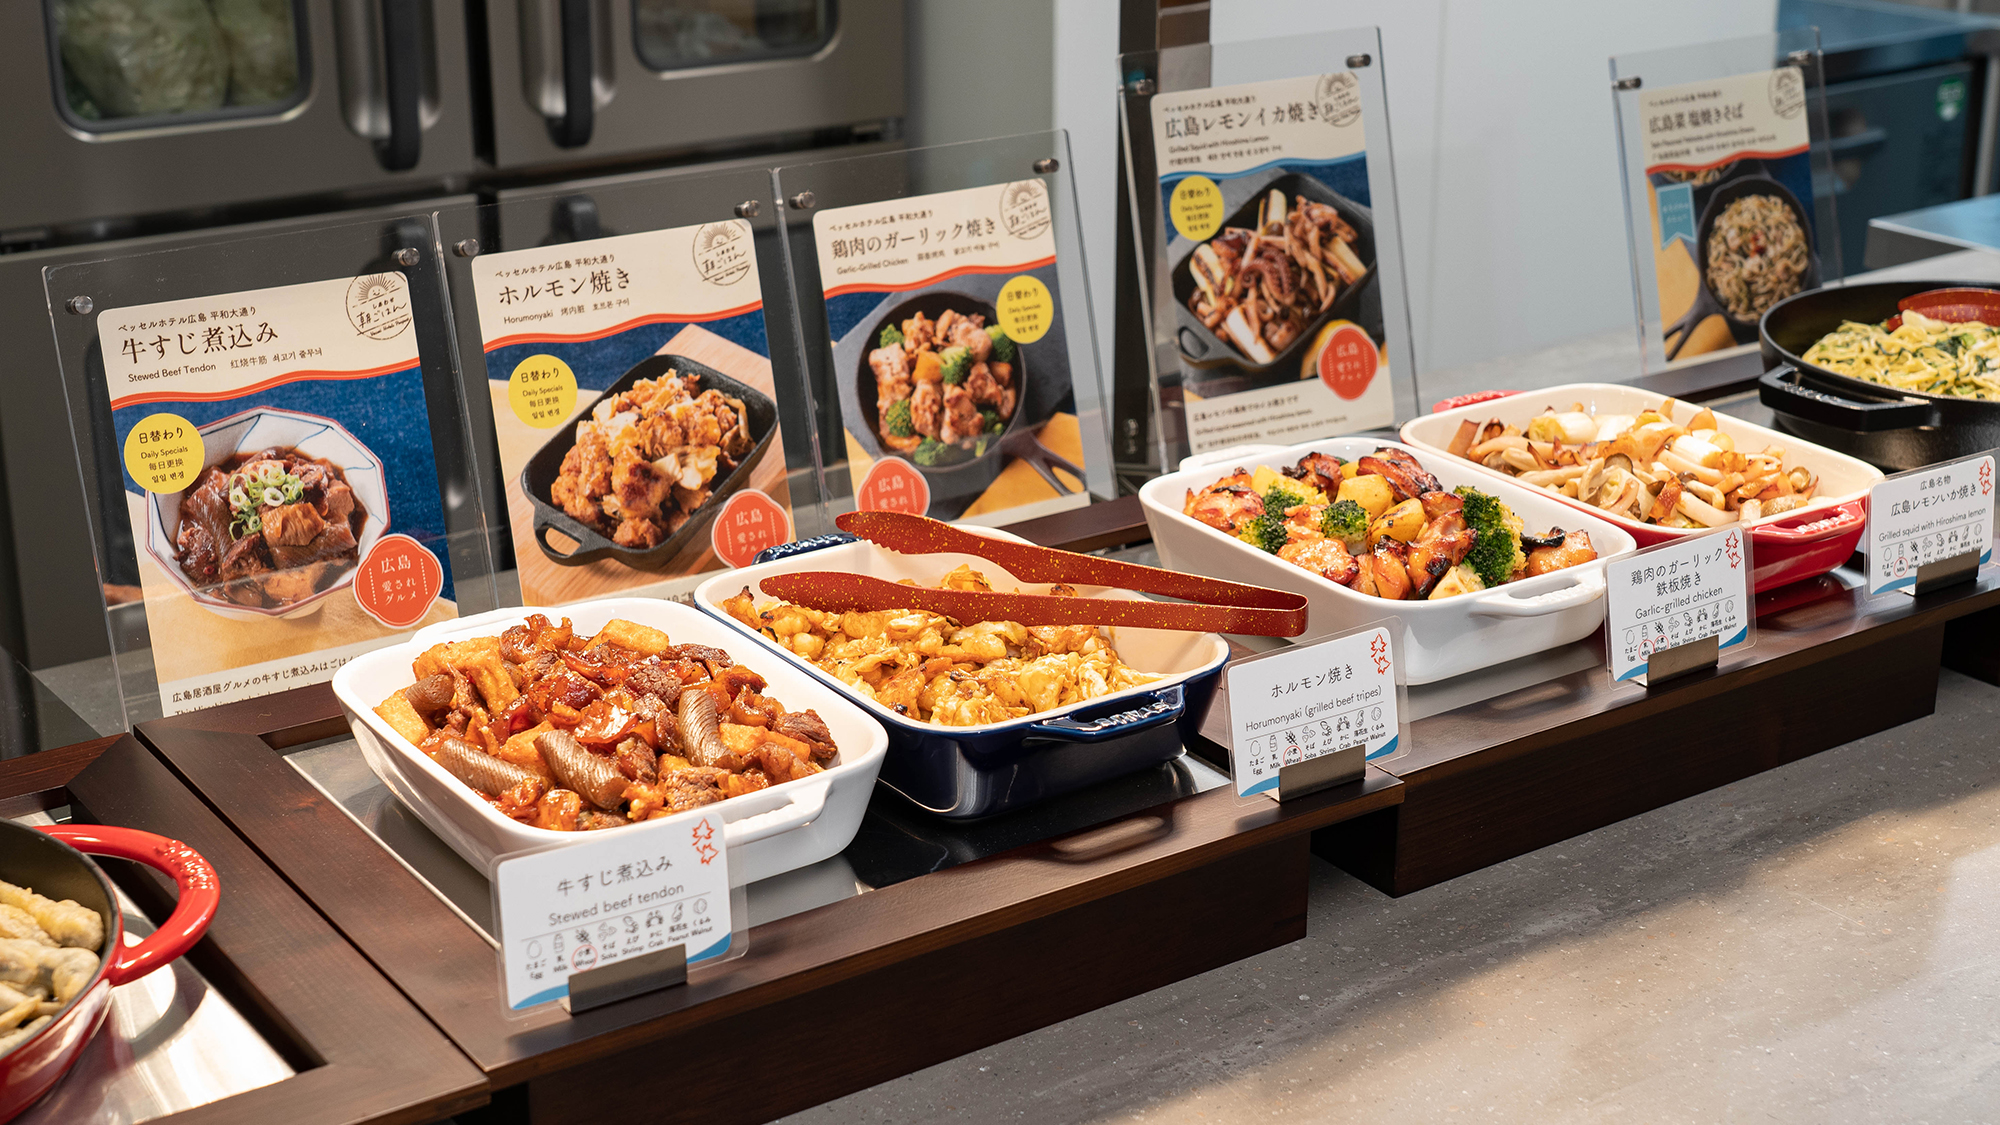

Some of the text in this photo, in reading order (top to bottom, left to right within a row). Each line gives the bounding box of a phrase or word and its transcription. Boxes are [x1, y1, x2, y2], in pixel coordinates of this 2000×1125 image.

[1165, 101, 1318, 139] 広島レモンイカ焼き
[831, 217, 995, 259] 鶏肉のガーリック焼き
[494, 254, 615, 278] ベッセルホテル広島 平和大通り
[499, 267, 630, 305] ホルモン焼き
[118, 306, 256, 332] ベッセルホテル広島 平和大通り
[504, 309, 554, 324] Horumonyaki
[121, 321, 278, 364] 牛すじ煮込み
[128, 363, 216, 383] Stewed Beef Tendon
[521, 367, 560, 383] 日替わり
[522, 385, 563, 397] Daily Specials
[139, 427, 183, 444] 日替わり
[140, 446, 189, 459] Daily Specials
[1920, 474, 1951, 491] 広島名物
[1891, 483, 1977, 517] 広島レモンいか焼き
[736, 508, 763, 527] 広島
[1879, 507, 1986, 542] Grilled squid with Hiroshima lemon
[381, 554, 411, 574] 広島
[1631, 548, 1723, 586] 鶏肉のガーリック
[382, 577, 417, 593] 愛され
[1656, 572, 1702, 597] 鉄板焼き
[385, 590, 417, 606] グルメ
[1635, 586, 1723, 620] Garlic-grilled chicken
[1271, 663, 1354, 698] ホルモン焼き
[1245, 685, 1382, 732] Horumonyaki (grilled beef tripes)
[1249, 756, 1265, 767] たまご
[1306, 742, 1316, 751] そば
[1323, 737, 1333, 746] えび
[1371, 723, 1385, 732] くるみ
[1253, 768, 1263, 776] Egg
[1270, 762, 1281, 770] Milk
[1320, 747, 1337, 756] Shrimp
[1353, 737, 1369, 746] Peanut
[1370, 732, 1386, 741] Walnut
[557, 855, 673, 897] 牛すじ煮込み
[549, 884, 685, 926] Stewed beef tendon
[649, 939, 665, 948] Crab
[668, 933, 690, 943] Peanut
[691, 926, 713, 936] Walnut
